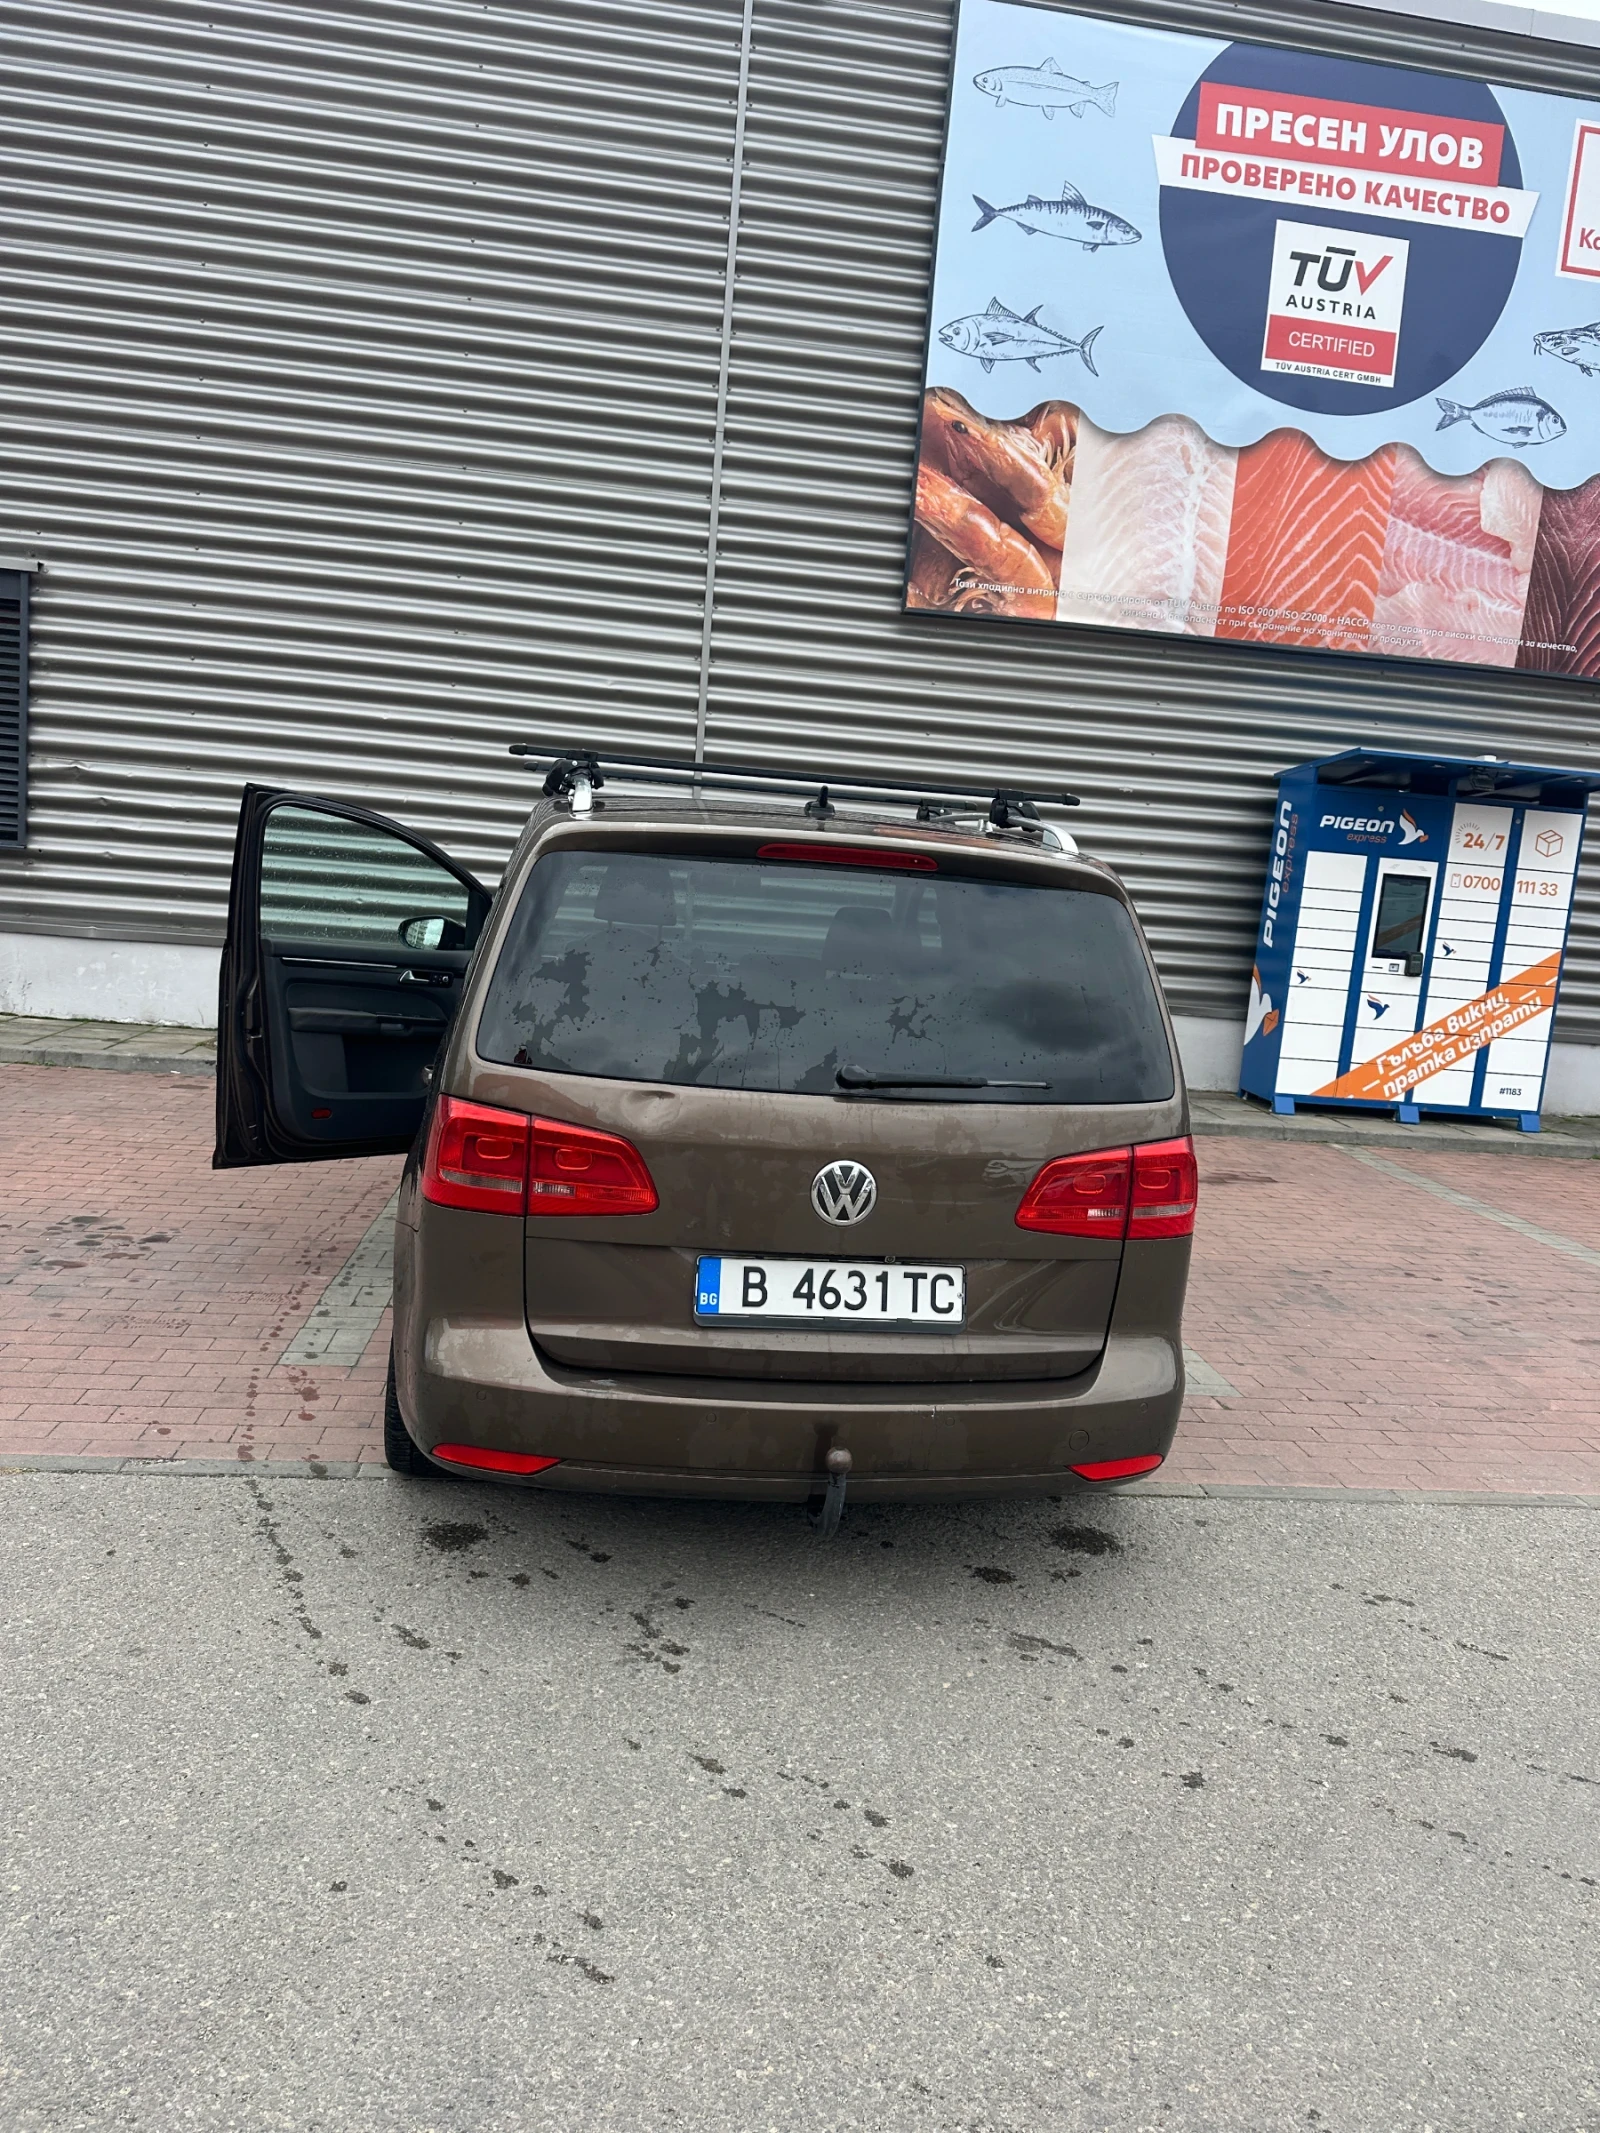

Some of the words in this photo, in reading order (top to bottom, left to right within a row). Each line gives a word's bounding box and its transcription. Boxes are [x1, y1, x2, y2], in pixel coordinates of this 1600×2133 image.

[1215, 102, 1367, 154] ПРЕСЕН
[1377, 127, 1484, 170] УЛОВ
[1180, 153, 1356, 201] ПРОВЕРЕНО
[1364, 180, 1510, 224] КАЧЕСТВО
[1285, 294, 1377, 320] AUSTRIA
[1288, 331, 1375, 358] CERTIFIED
[1275, 362, 1292, 371] TÜV
[1294, 365, 1330, 376] AUSTRIA
[1333, 370, 1355, 380] CERT
[1357, 373, 1381, 383] GMBH
[954, 578, 976, 589] Тази
[978, 582, 1025, 594] хладилна
[1027, 587, 1067, 598] витрина
[1190, 600, 1223, 613] Austria
[1224, 605, 1237, 614] по
[1238, 605, 1255, 616] ISO
[1282, 609, 1299, 620] ISO
[1300, 611, 1328, 623] 22000
[1371, 622, 1396, 632] което
[1398, 625, 1444, 638] гарантира
[1445, 630, 1476, 641] високи
[1477, 634, 1524, 647] стандарти
[1525, 640, 1536, 649] за
[1536, 641, 1578, 653] качество,
[1120, 609, 1158, 620] хигиена
[1229, 620, 1246, 630] при
[1248, 621, 1302, 634] съхранение
[1303, 626, 1315, 635] на
[1316, 627, 1378, 641] хранителните
[1319, 814, 1395, 834] PIGEON
[1346, 833, 1387, 844] express
[1282, 813, 1298, 893] express
[1463, 832, 1505, 851] 24/7
[1263, 800, 1292, 948] PIGEON
[1463, 874, 1501, 891] 0700
[1517, 880, 1536, 894] 111
[1538, 882, 1558, 896] 33
[1376, 1027, 1446, 1075] Гълъба
[1383, 1046, 1456, 1098] пратка
[1458, 995, 1542, 1051] изпрати
[1499, 1087, 1522, 1096] #1183
[699, 1292, 718, 1306] BG
[741, 1266, 768, 1308] B
[792, 1268, 889, 1313] 4631
[903, 1271, 955, 1315] TC
